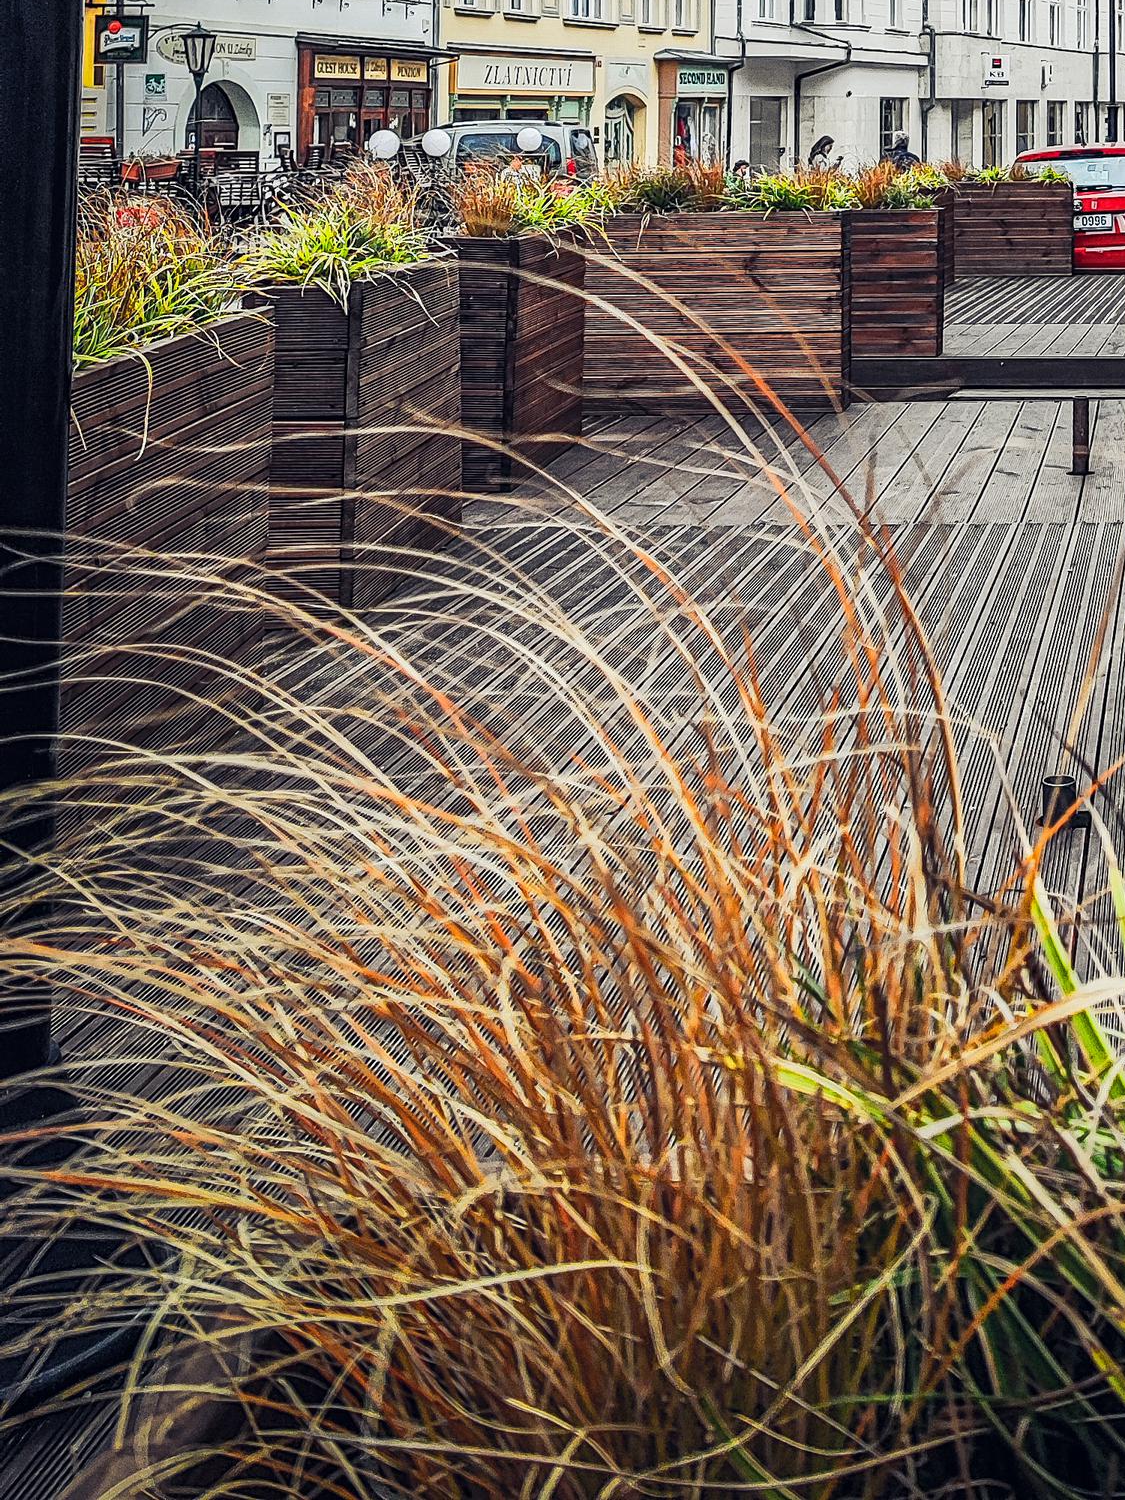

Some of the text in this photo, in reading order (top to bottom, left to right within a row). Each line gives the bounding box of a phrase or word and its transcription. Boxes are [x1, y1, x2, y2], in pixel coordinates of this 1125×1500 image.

[317, 61, 336, 74] GUEST
[337, 62, 357, 75] HOUSE
[483, 63, 572, 87] ZLATNICTVÍ
[679, 72, 725, 85] SECOND HAND
[1081, 215, 1107, 227] 0996
